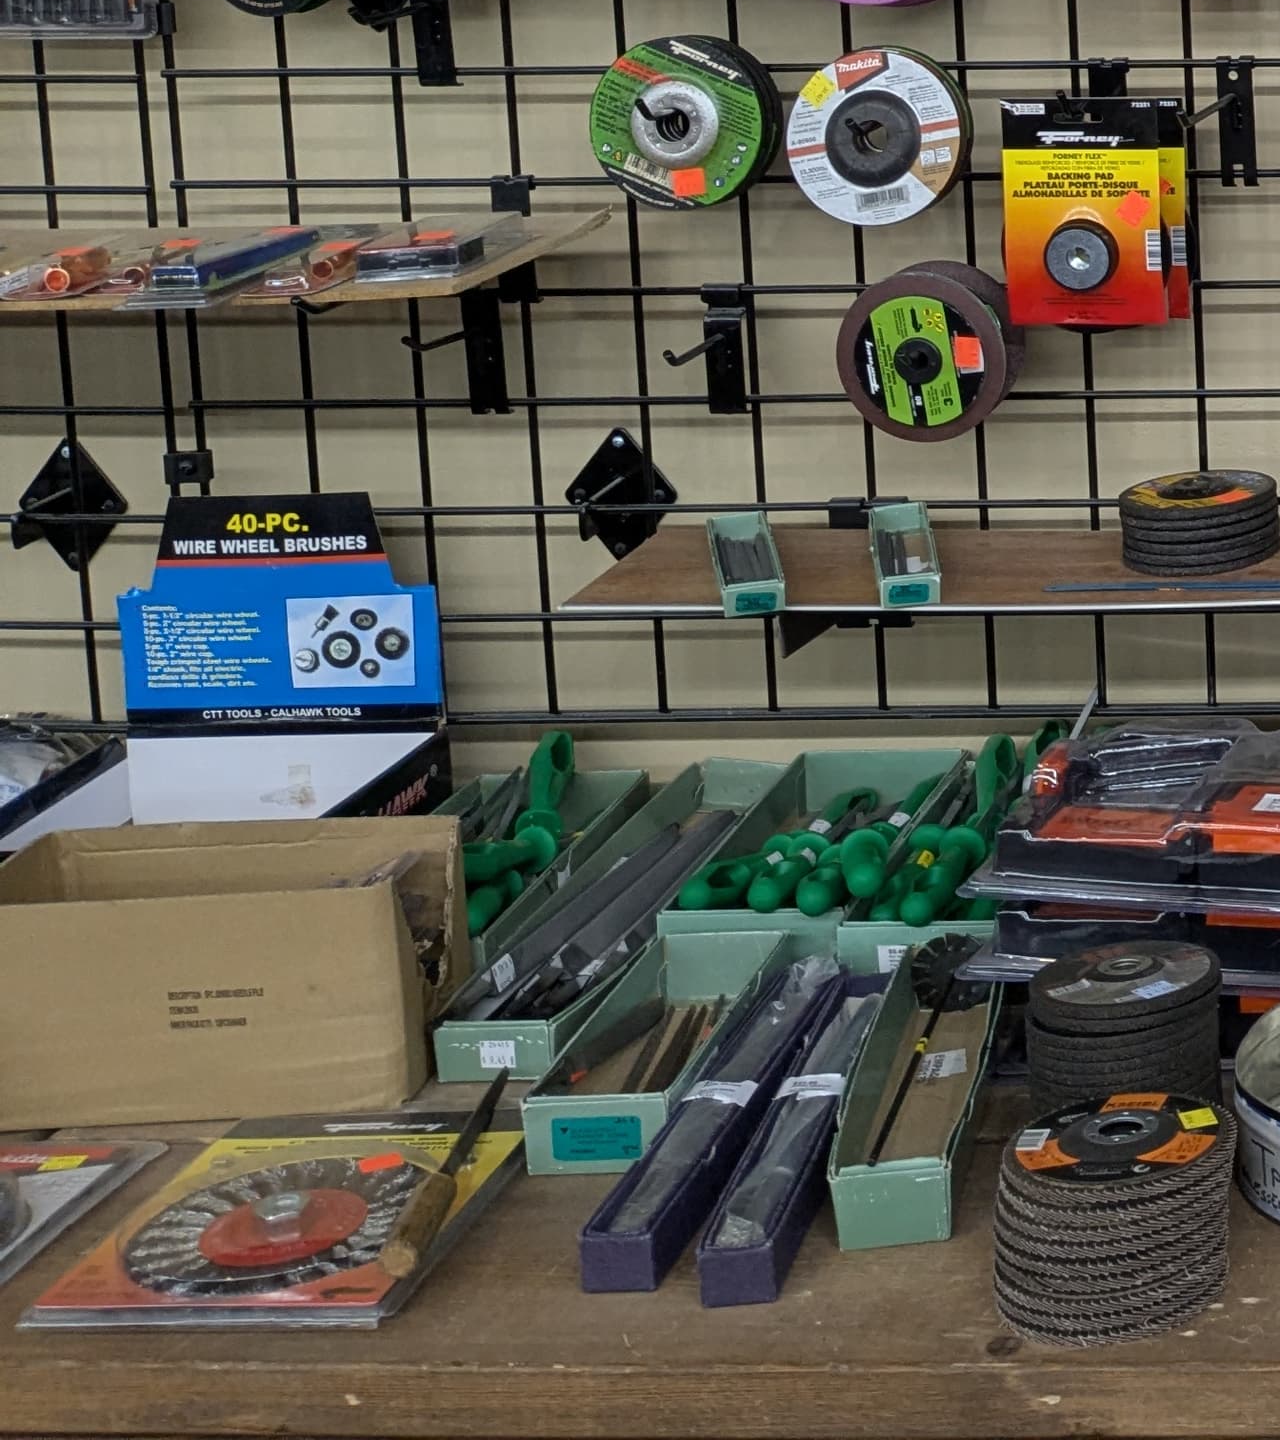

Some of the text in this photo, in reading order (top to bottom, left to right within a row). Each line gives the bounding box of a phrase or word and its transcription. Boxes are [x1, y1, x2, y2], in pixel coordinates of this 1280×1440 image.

[669, 40, 741, 80] Forney
[837, 58, 882, 73] makita
[1037, 131, 1121, 147] Forney
[1023, 181, 1139, 189] PLATEAU PORTE-DISQUE
[1012, 190, 1103, 198] ALMOHADILLAS DE
[226, 513, 309, 533] 40-PC.
[173, 535, 367, 554] WIRE WHEEL BRUSHES
[203, 707, 361, 719] CTT TOOLS CALHAWK TOOLS
